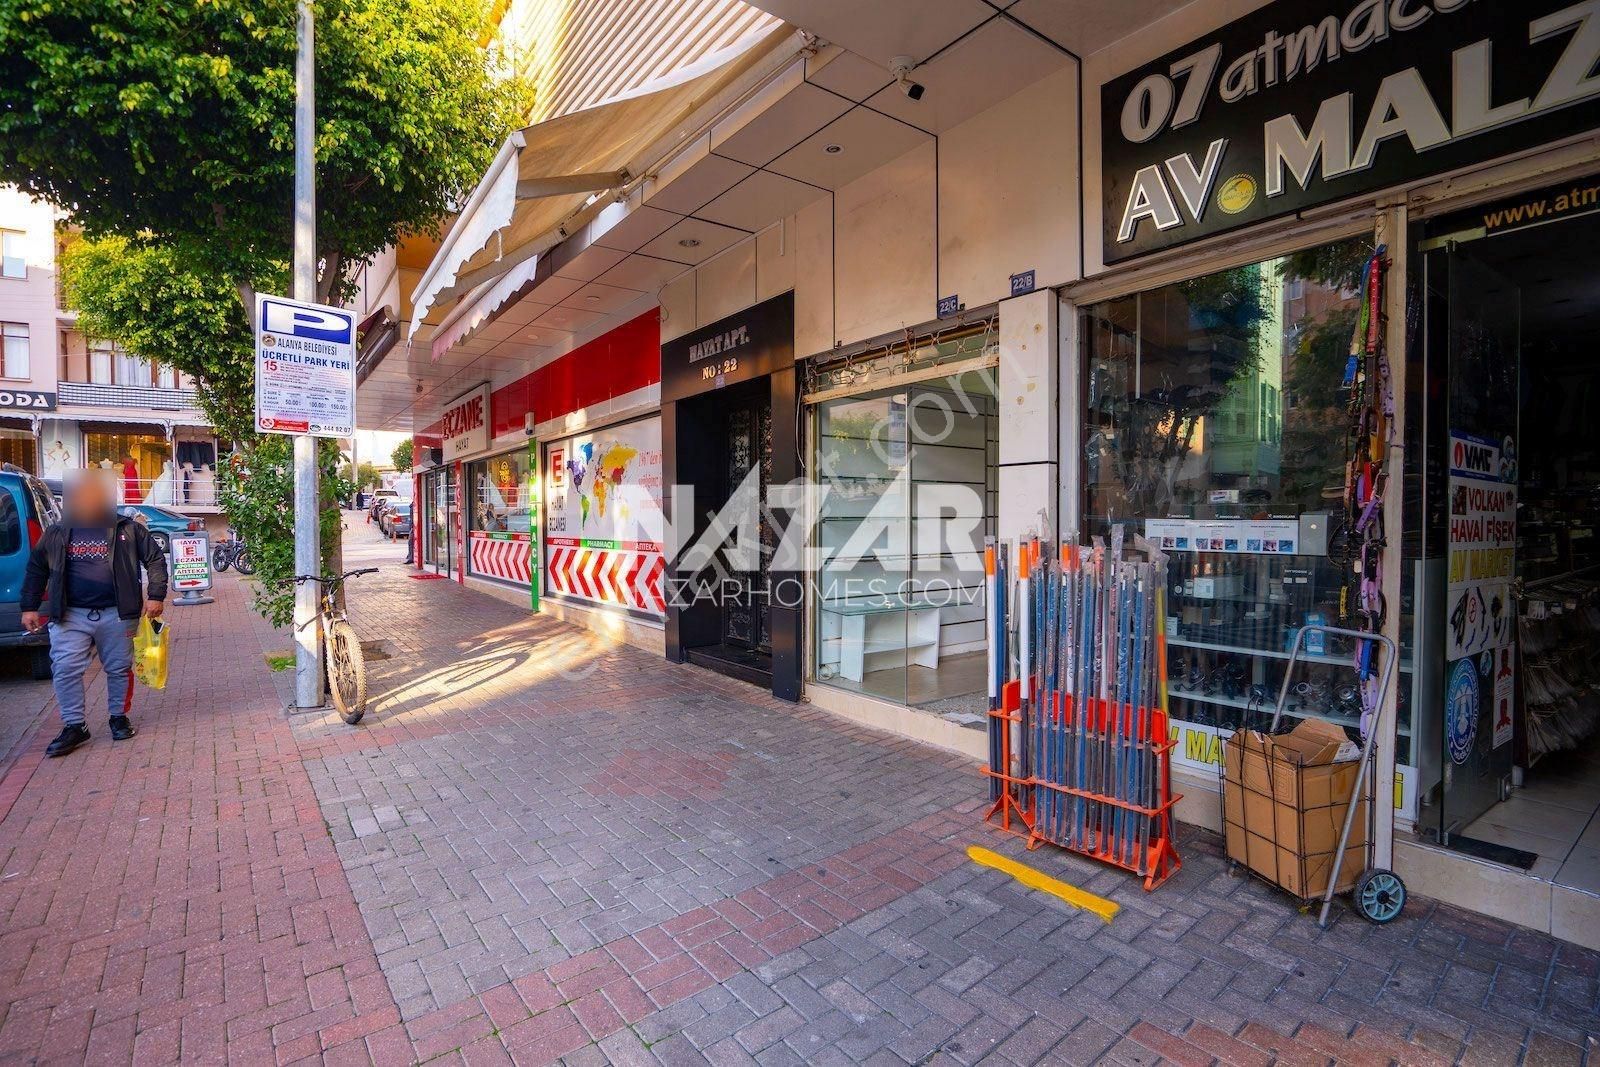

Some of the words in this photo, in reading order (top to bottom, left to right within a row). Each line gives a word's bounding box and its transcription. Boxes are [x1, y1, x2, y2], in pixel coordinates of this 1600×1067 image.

[1120, 43, 1222, 143] 07
[1219, 0, 1477, 103] atmac
[1116, 138, 1229, 243] AV
[262, 347, 301, 363] ÜCRETLİ
[305, 356, 328, 367] PARK
[330, 360, 350, 370] YERİ
[278, 338, 302, 351] ALANYA
[304, 341, 337, 356] BELEDİYESİ
[689, 334, 723, 364] HAYAT
[264, 360, 278, 371] 15
[443, 395, 484, 439] ECZANE
[1468, 487, 1505, 512] VOLKAN
[586, 540, 614, 549] PHARMACY
